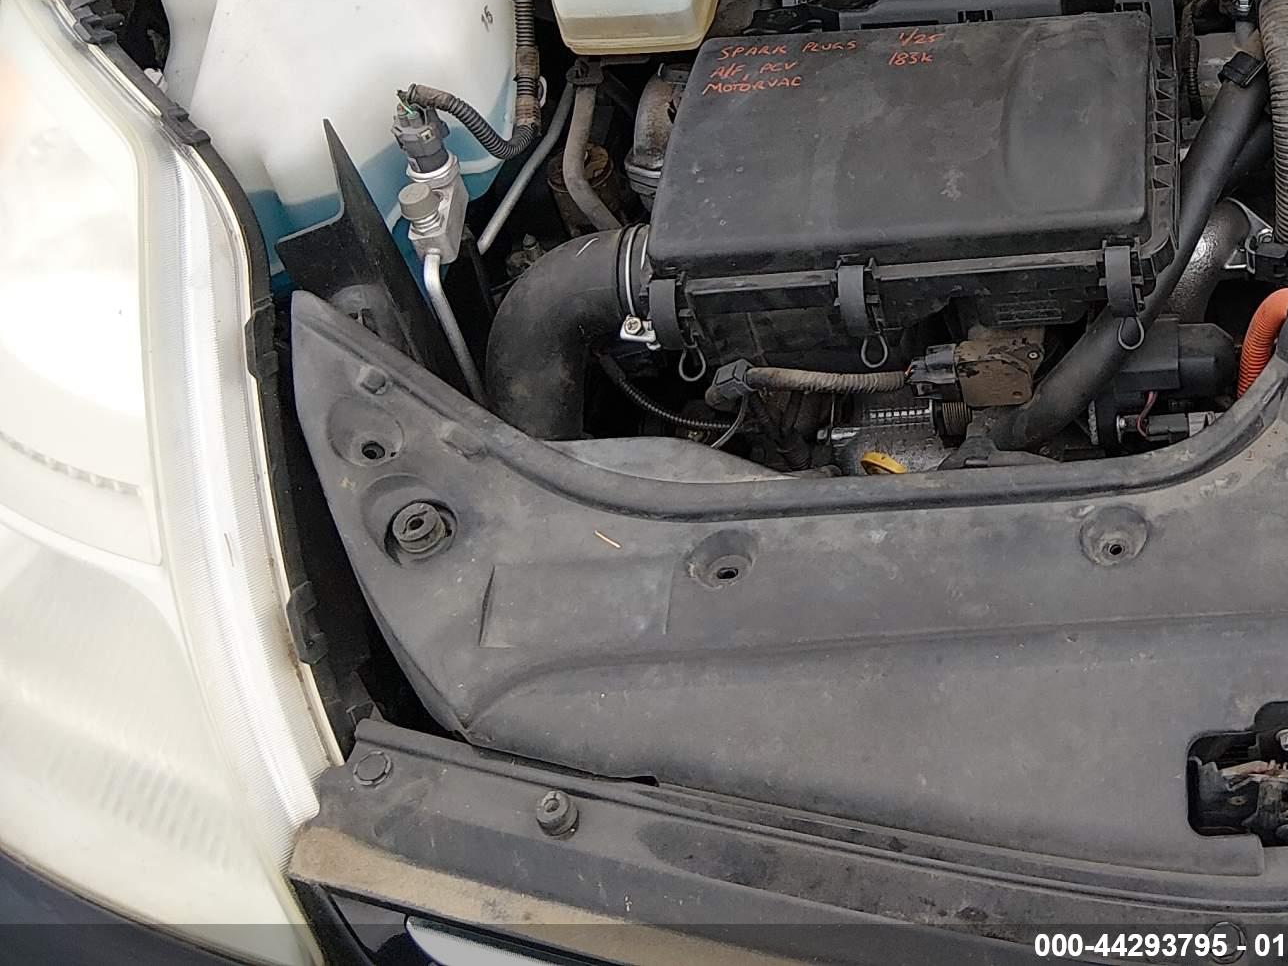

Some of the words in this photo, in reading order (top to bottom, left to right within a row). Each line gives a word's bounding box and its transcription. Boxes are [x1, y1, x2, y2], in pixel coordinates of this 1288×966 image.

[717, 44, 788, 61] SPARK
[801, 40, 858, 54] PLUGS
[759, 60, 799, 75] PCV
[701, 76, 802, 96] MOTORVAC
